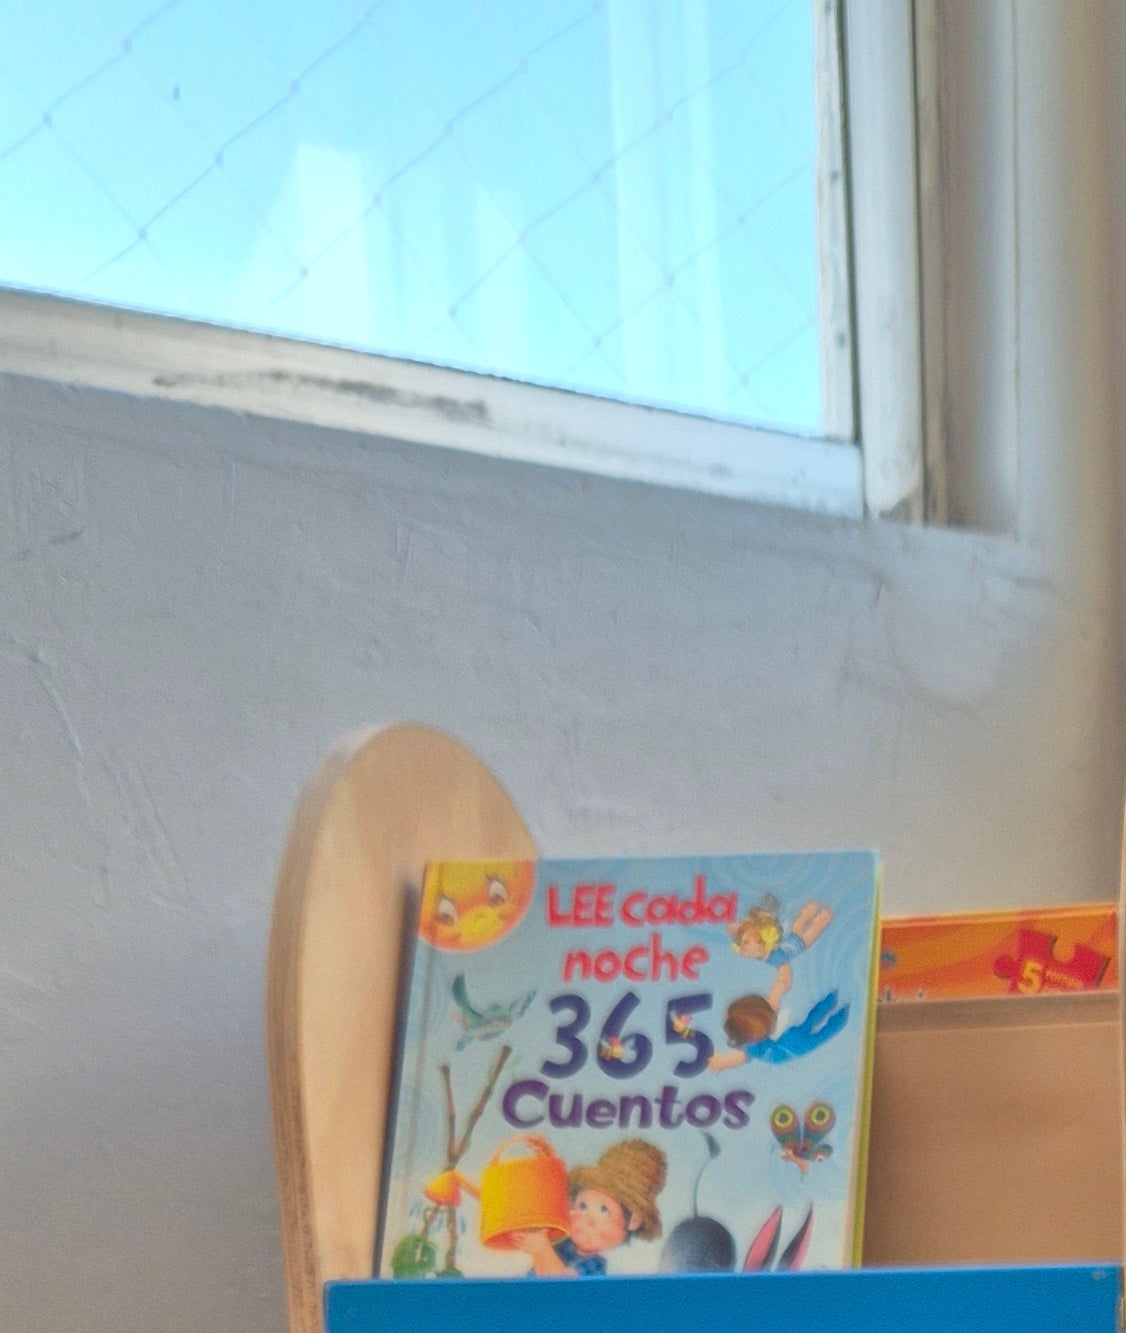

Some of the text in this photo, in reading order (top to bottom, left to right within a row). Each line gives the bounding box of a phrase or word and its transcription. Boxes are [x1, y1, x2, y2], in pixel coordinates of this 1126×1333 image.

[547, 873, 739, 928] LEE cada
[561, 930, 711, 984] noche
[538, 991, 715, 1080] 365
[501, 1078, 756, 1130] Cuentos
